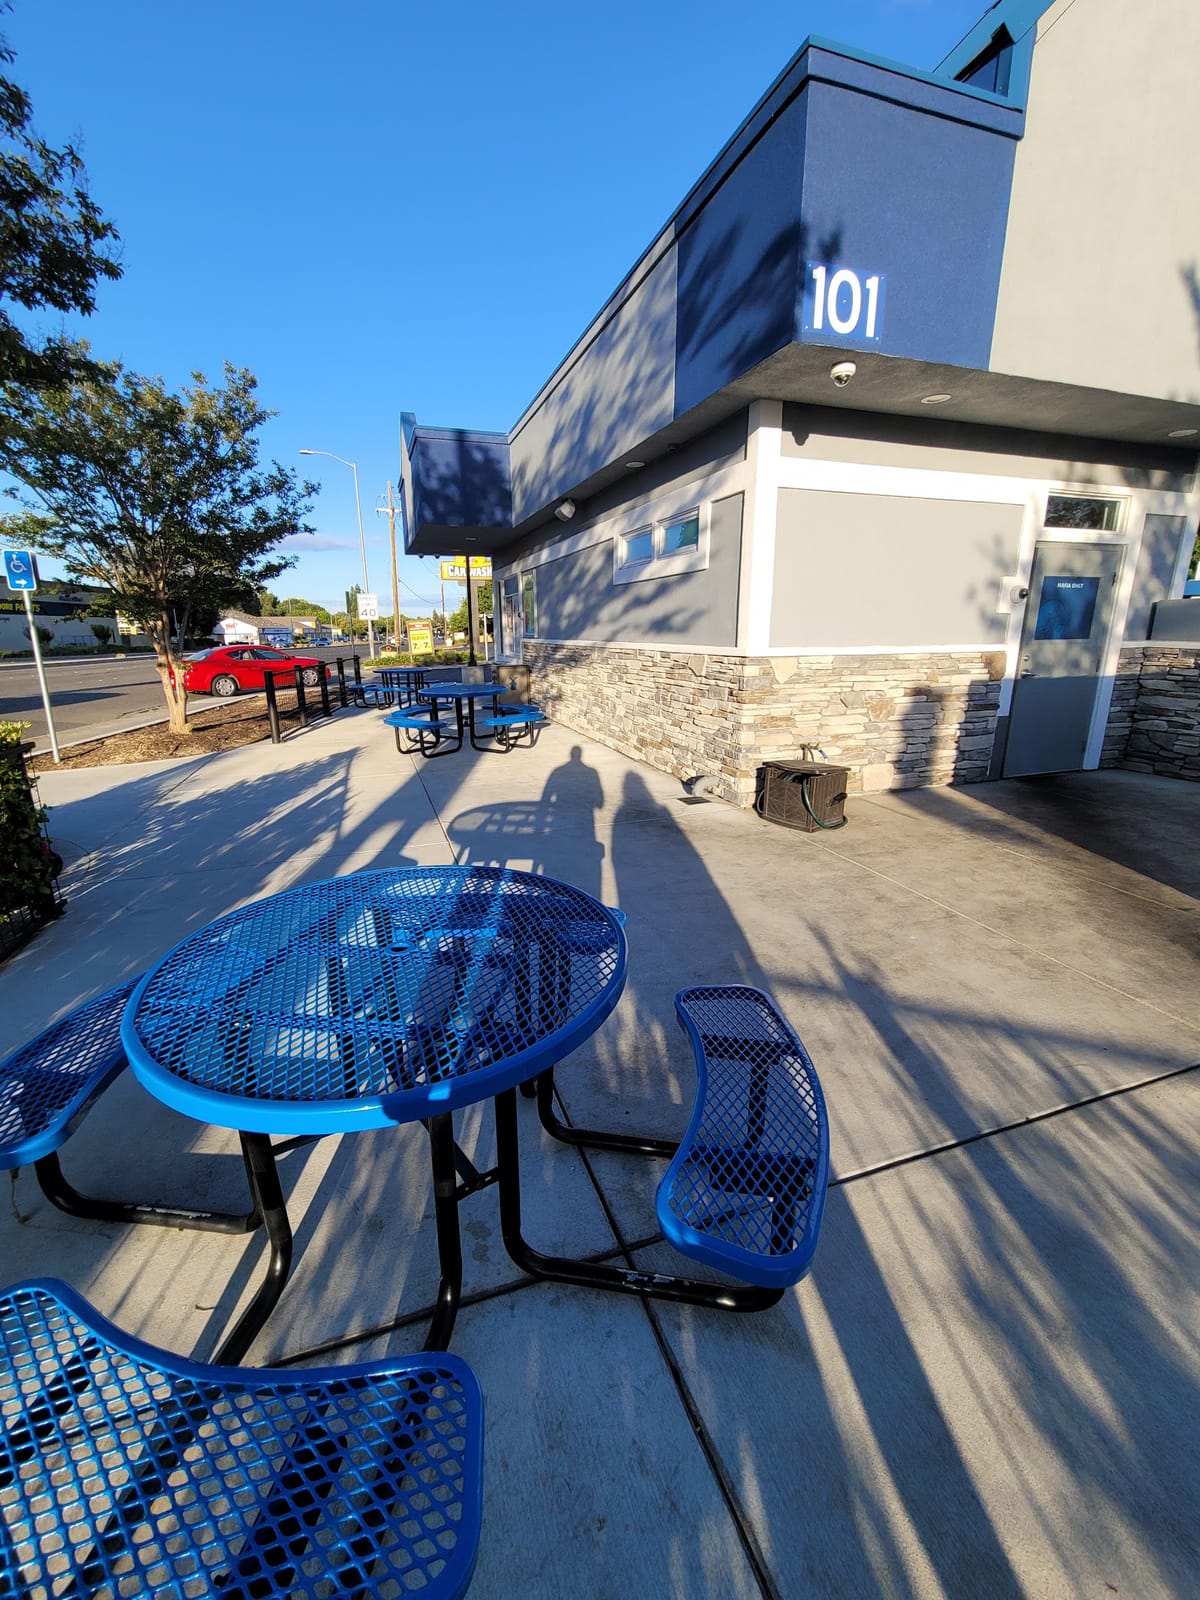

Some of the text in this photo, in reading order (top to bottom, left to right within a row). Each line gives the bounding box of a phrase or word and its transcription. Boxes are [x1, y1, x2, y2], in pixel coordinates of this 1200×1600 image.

[812, 265, 879, 338] 101
[447, 564, 467, 577] CAR
[15, 603, 40, 612] PATS
[361, 608, 377, 617] 40
